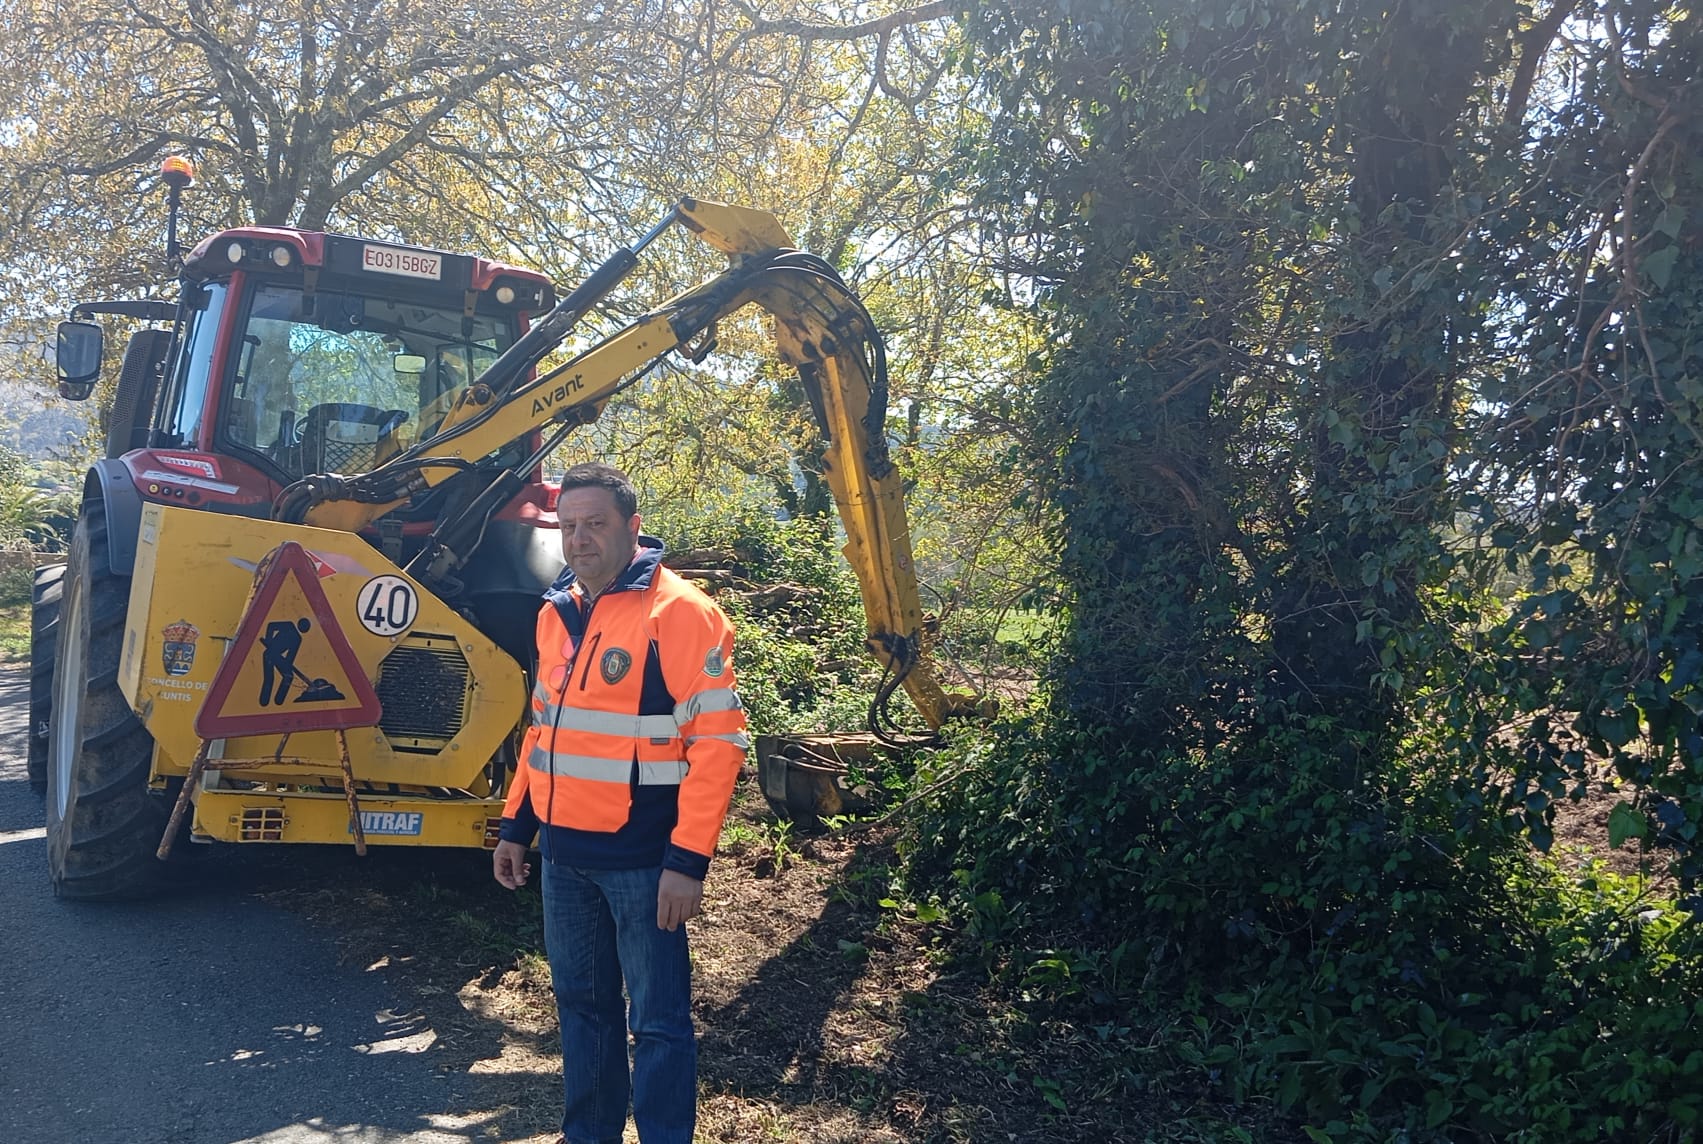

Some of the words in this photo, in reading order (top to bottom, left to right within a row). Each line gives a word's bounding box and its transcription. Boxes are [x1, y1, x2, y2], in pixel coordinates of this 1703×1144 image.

[531, 374, 584, 417] Avant
[364, 583, 411, 628] 40
[150, 678, 193, 689] ONCELLO
[195, 681, 209, 691] DE
